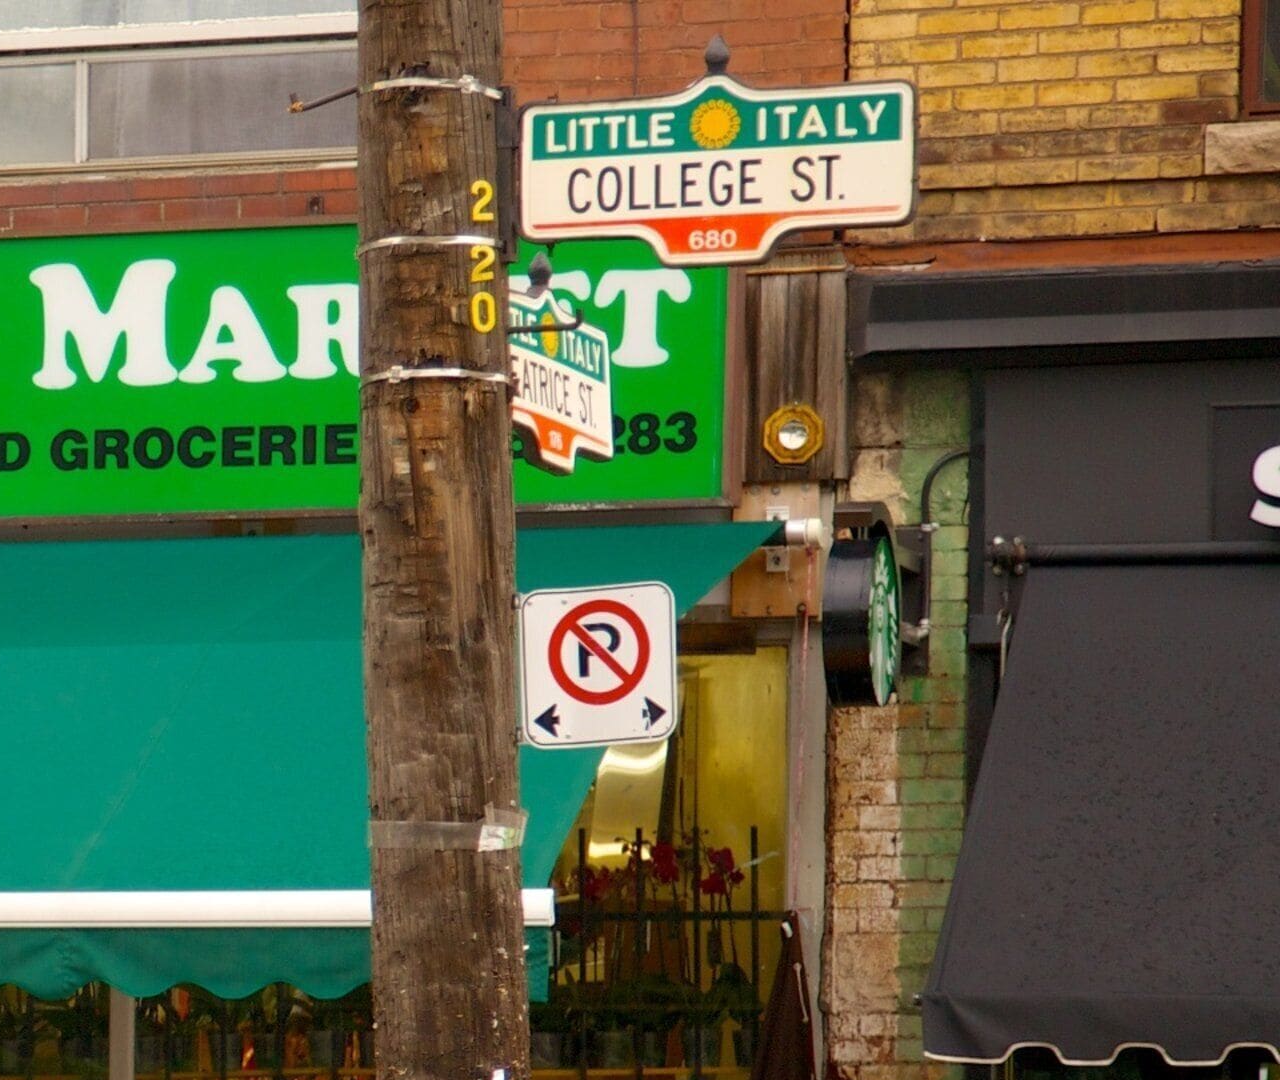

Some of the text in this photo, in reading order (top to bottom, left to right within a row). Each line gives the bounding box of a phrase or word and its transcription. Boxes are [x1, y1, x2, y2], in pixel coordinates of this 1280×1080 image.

[546, 100, 886, 153] LITTLE ITALY
[568, 155, 845, 213] COLLEGE ST.
[688, 230, 737, 250] 680
[30, 259, 691, 392] MART
[562, 330, 601, 376] ITALY
[510, 354, 572, 418] EATRICE
[49, 424, 358, 470] GROCERIE
